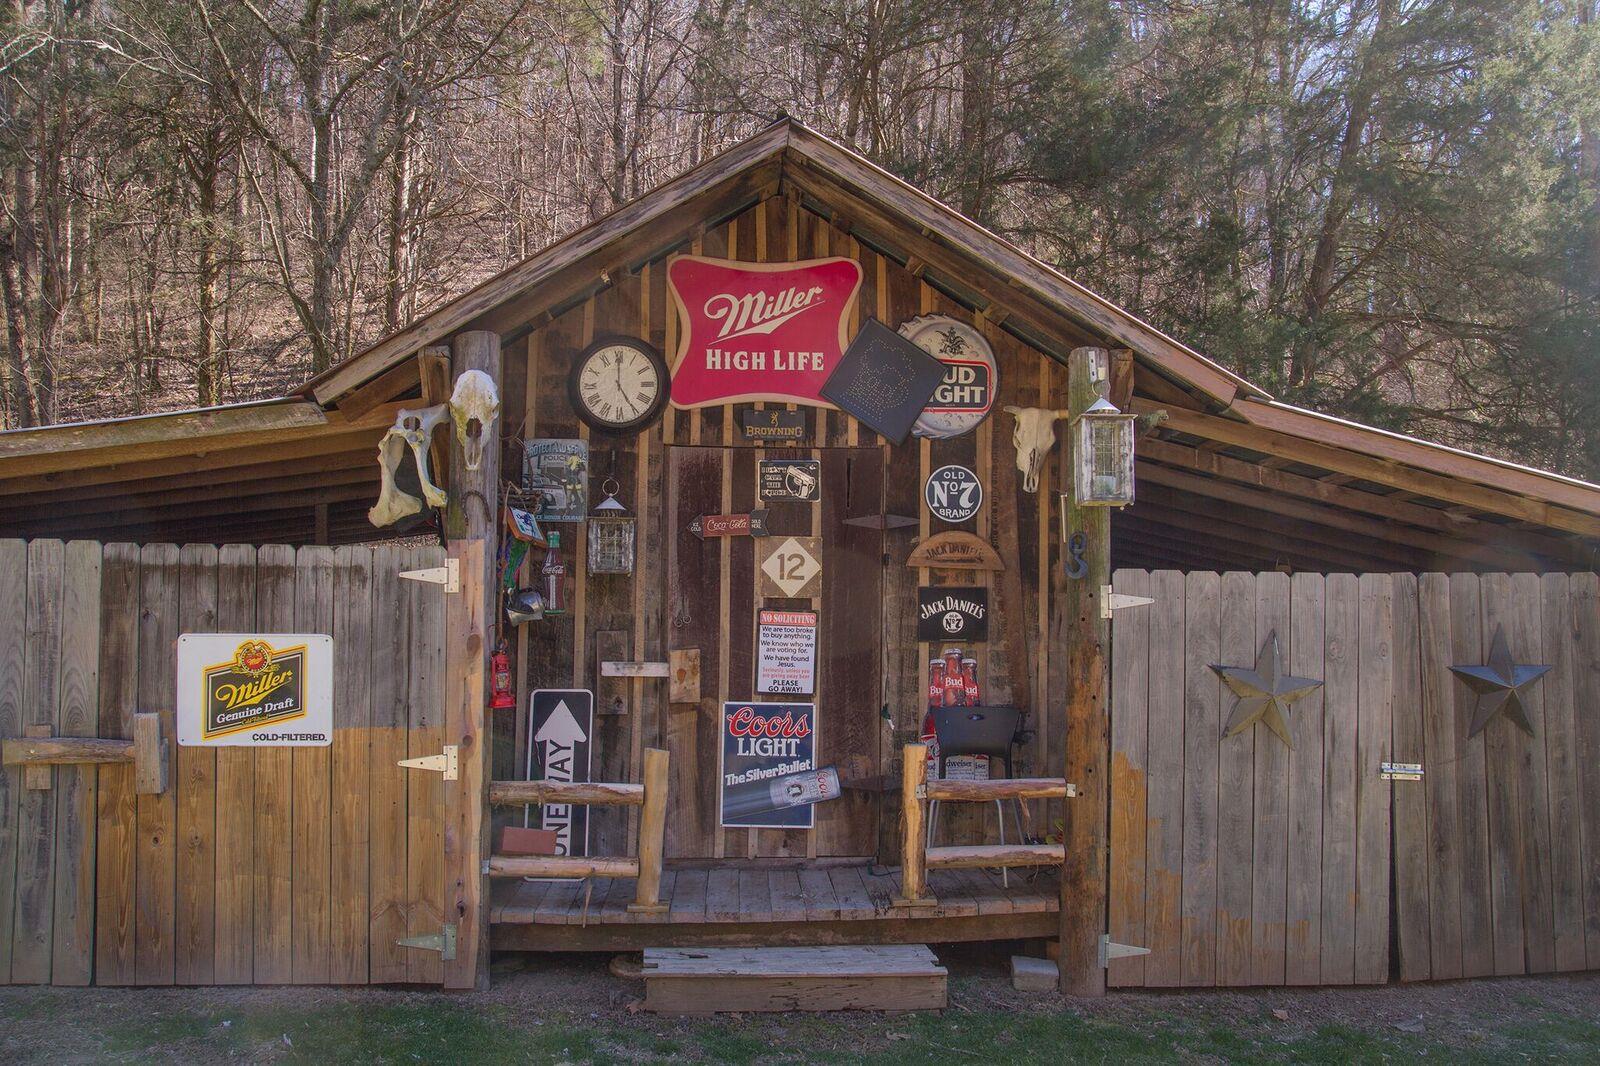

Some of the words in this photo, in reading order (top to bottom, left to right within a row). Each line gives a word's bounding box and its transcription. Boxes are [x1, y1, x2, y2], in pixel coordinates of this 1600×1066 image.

[703, 286, 823, 338] Miller
[705, 348, 766, 370] HIGH
[774, 350, 825, 371] LIFE
[942, 366, 976, 384] UD
[930, 385, 984, 404] GHT
[746, 425, 803, 438] BROWNING
[943, 471, 965, 480] OLD
[939, 508, 970, 518] BRAND
[706, 518, 747, 532] Coca-Cola
[776, 553, 806, 580] 12
[920, 600, 946, 620] JACK
[946, 596, 986, 619] DANIEL'S
[760, 613, 773, 622] NO
[773, 613, 816, 624] SOLICITING
[215, 670, 294, 709] Miller
[945, 677, 963, 686] Bud
[966, 686, 978, 695] ud
[216, 706, 262, 724] Genuine
[264, 697, 294, 712] Draft
[726, 706, 812, 738] Coors
[736, 738, 800, 757] LIGHT
[549, 739, 572, 782] AY
[946, 760, 972, 768] dweiser
[724, 773, 746, 786] The
[745, 768, 779, 782] Silver
[778, 759, 811, 776] Bullet
